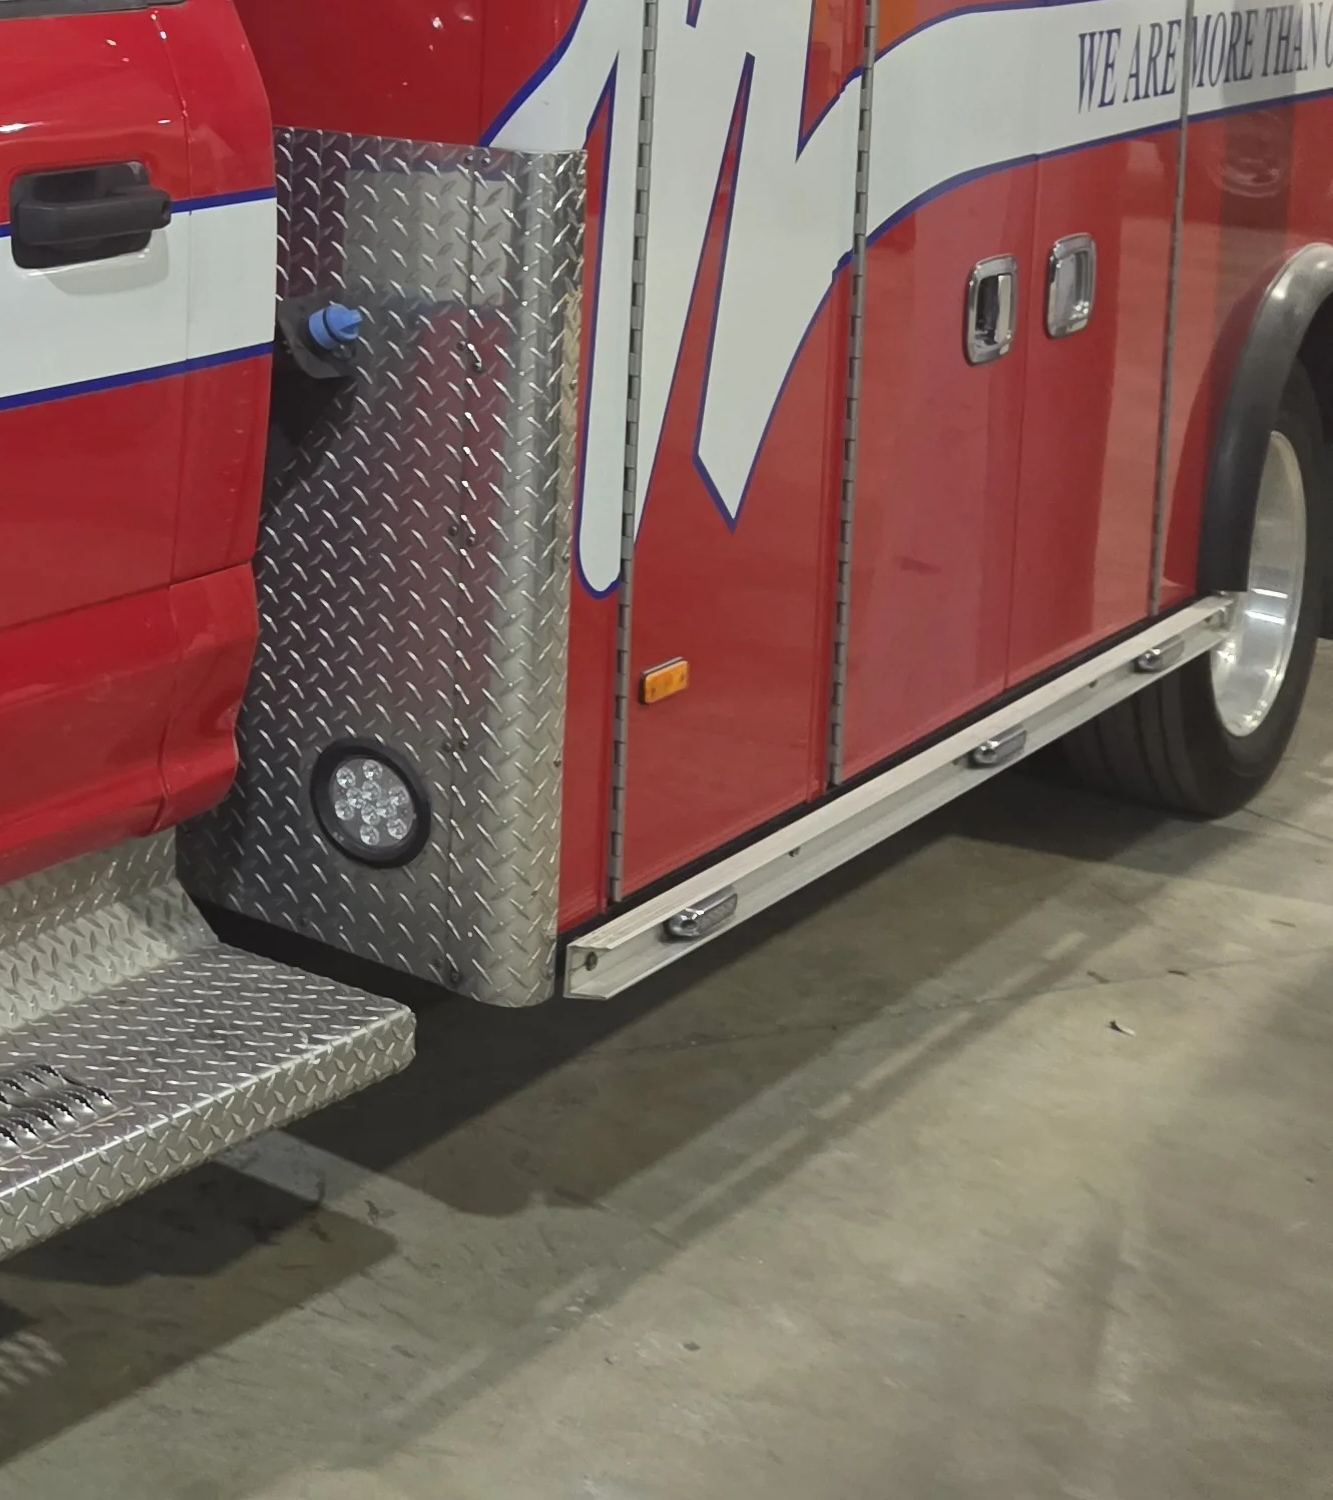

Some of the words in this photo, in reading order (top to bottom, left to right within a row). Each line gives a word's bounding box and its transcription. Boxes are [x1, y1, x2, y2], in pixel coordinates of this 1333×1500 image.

[1077, 27, 1122, 114] WE
[1122, 18, 1182, 103] ARE
[1189, 9, 1259, 88] MORE
[1261, 1, 1324, 77] THAN
